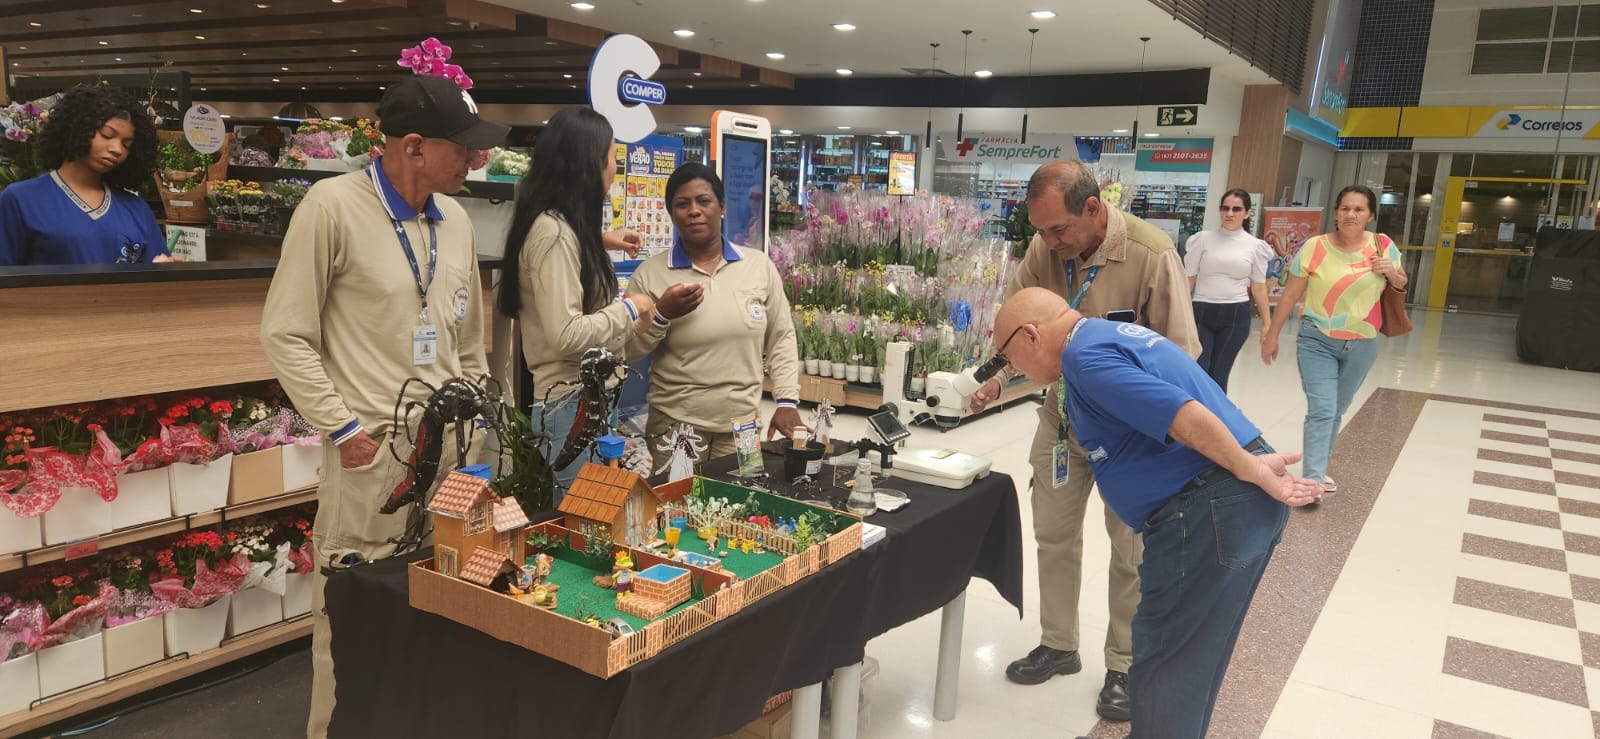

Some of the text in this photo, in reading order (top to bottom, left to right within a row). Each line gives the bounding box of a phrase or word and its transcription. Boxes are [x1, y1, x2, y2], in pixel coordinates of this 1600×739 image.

[625, 83, 663, 100] COMPER
[1522, 119, 1583, 131] Correios
[977, 144, 1062, 160] SempreFort
[653, 160, 675, 168] TODOS
